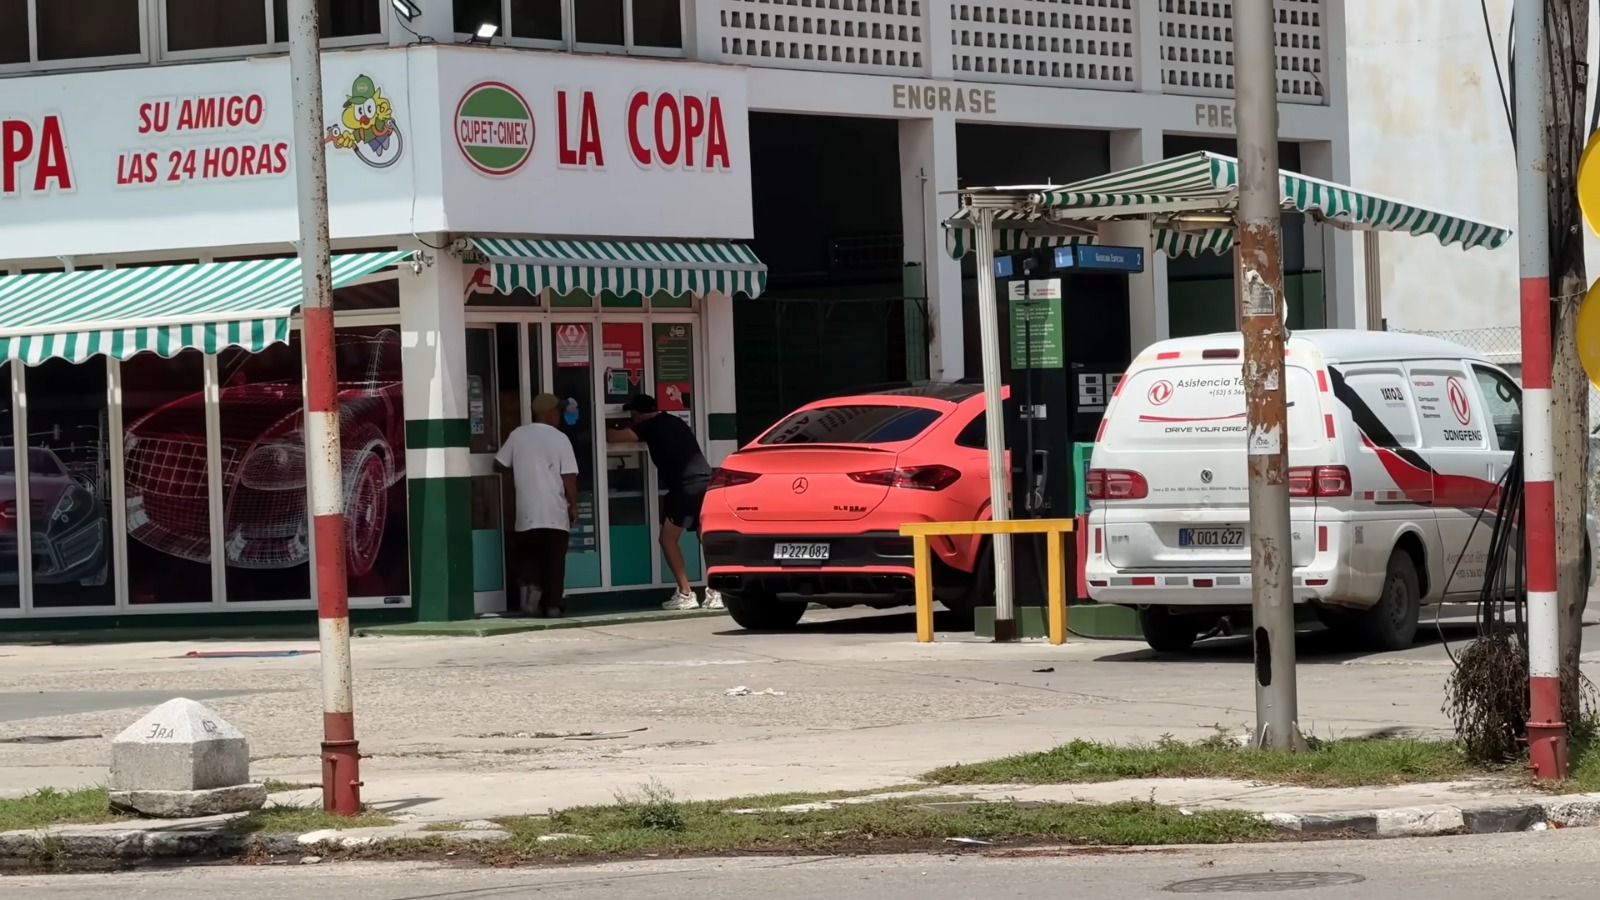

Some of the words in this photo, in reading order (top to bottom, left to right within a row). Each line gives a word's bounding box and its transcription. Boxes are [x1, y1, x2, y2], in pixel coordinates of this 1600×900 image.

[892, 83, 997, 114] ENGRASE
[138, 102, 170, 134] SU
[176, 94, 264, 131] AMIGO
[460, 119, 529, 146] CUPET-CIMEX
[557, 90, 604, 167] LA
[627, 90, 731, 169] COPA
[116, 152, 158, 185] LAS
[167, 149, 197, 182] 24
[202, 142, 289, 178] HORAS
[1136, 253, 1141, 266] 2
[1177, 378, 1231, 388] Asistencia
[1233, 377, 1246, 387] Te
[1443, 429, 1483, 442] DONGFENG
[1188, 530, 1196, 545] K
[1197, 531, 1219, 545] 001
[1221, 530, 1243, 545] 627
[781, 545, 788, 559] P
[789, 545, 808, 559] 227
[808, 544, 829, 558] 082
[145, 723, 175, 739] 3RA
